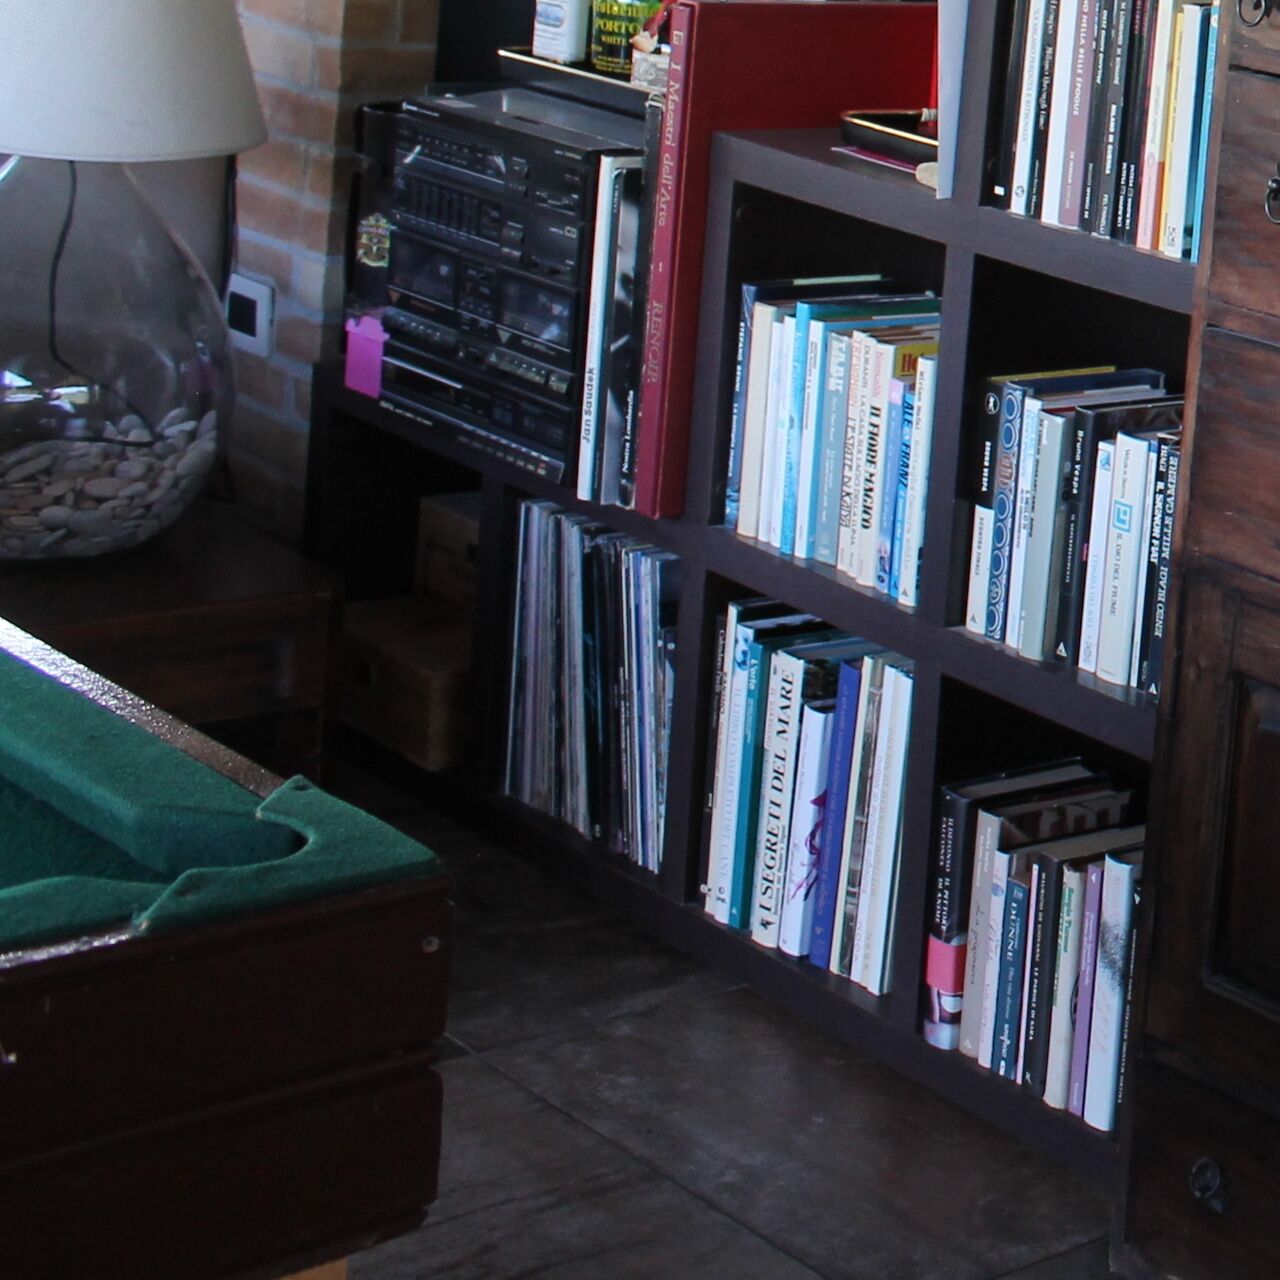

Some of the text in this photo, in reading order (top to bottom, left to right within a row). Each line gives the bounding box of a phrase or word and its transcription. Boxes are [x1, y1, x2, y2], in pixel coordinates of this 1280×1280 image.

[1077, 14, 1089, 45] NELLA
[1075, 47, 1086, 74] BELLE
[1107, 103, 1118, 134] MILANO
[1103, 143, 1114, 175] GUERRA
[646, 60, 682, 384] I Maestri RENOIR
[1097, 193, 1109, 234] FELTRINELLI
[736, 321, 746, 361] STEFANO
[860, 343, 870, 389] DURANTI
[581, 365, 595, 444] Jan Saudek
[897, 400, 914, 488] ALE FRANZ
[1068, 429, 1085, 494] Bruno Vespa
[1157, 443, 1168, 472] BIAGI
[858, 404, 881, 530] IL FIORE MAGICO
[1151, 492, 1164, 537] SIGNOR
[1150, 538, 1160, 565] FIAT
[1153, 455, 1179, 637] ENZO BIAGI MILLE CAMERE
[1111, 563, 1121, 583] DEL
[1108, 584, 1119, 617] FIUME
[758, 669, 795, 913] I SEGRETI DEL MARE
[933, 891, 943, 924] ANIME
[1004, 901, 1018, 962] DUNNE
